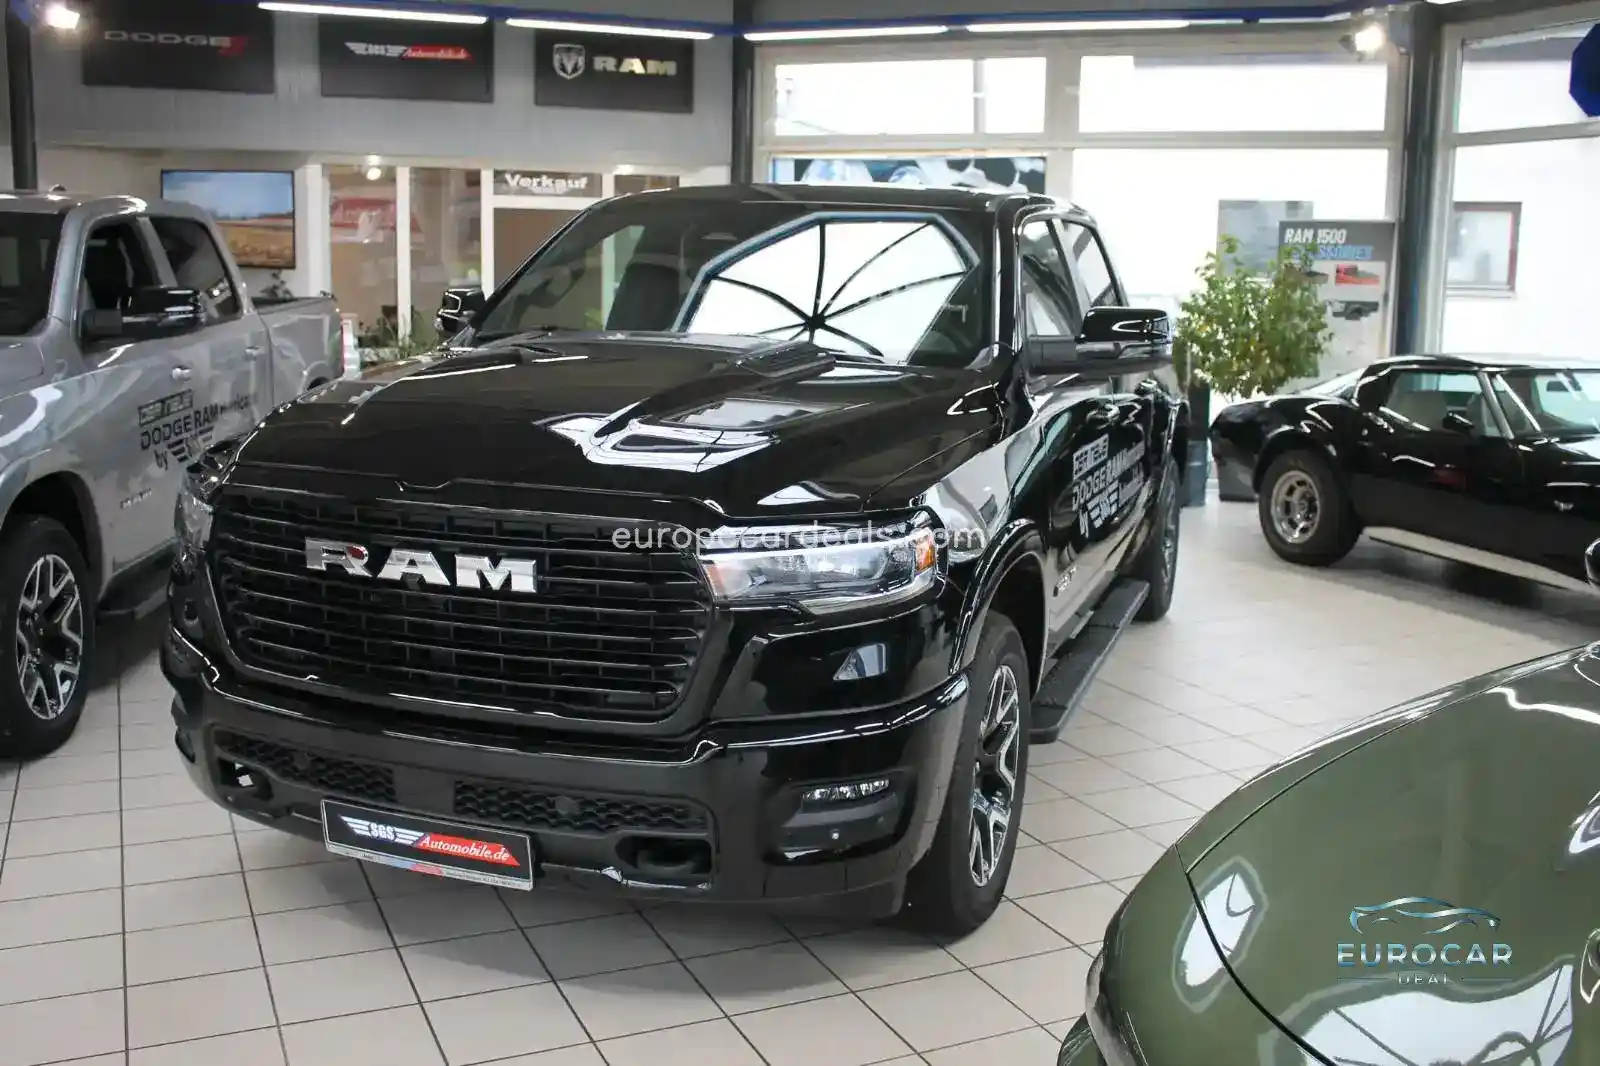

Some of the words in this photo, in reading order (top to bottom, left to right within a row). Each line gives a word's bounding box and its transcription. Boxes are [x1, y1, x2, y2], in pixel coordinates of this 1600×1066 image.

[104, 30, 232, 48] DODGE
[592, 56, 678, 76] RAM
[504, 172, 588, 190] Verkauf
[1284, 228, 1314, 244] RAM
[1317, 228, 1348, 245] 1500
[140, 414, 193, 451] DODGE
[194, 402, 219, 429] RAM
[1072, 468, 1106, 512] DODGE
[305, 537, 537, 593] RAM
[369, 822, 395, 843] SGS
[420, 836, 510, 862] Automobile.de
